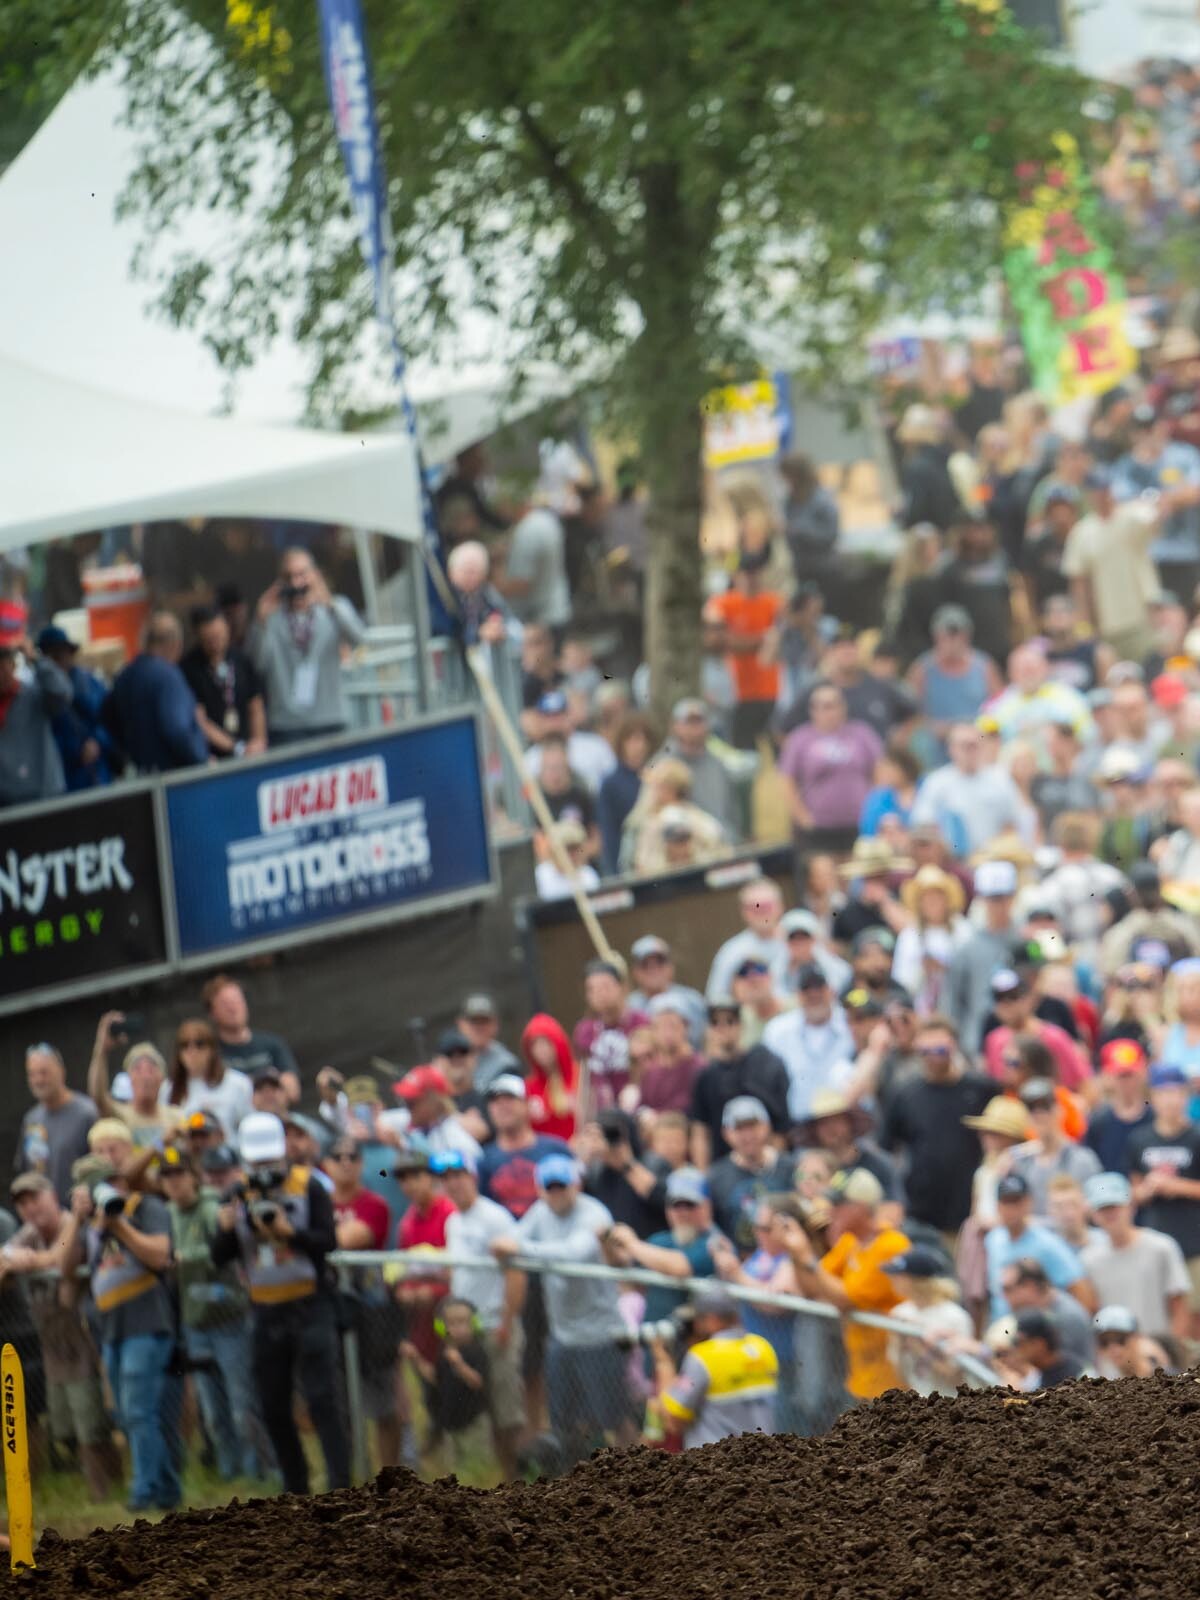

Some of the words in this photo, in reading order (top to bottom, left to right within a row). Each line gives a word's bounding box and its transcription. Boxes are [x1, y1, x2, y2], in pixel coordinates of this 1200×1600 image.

[270, 772, 338, 827] LUCAS
[347, 766, 378, 804] OIL
[227, 816, 431, 912] MOTOCROSS
[5, 1373, 16, 1454] ACERBIS
